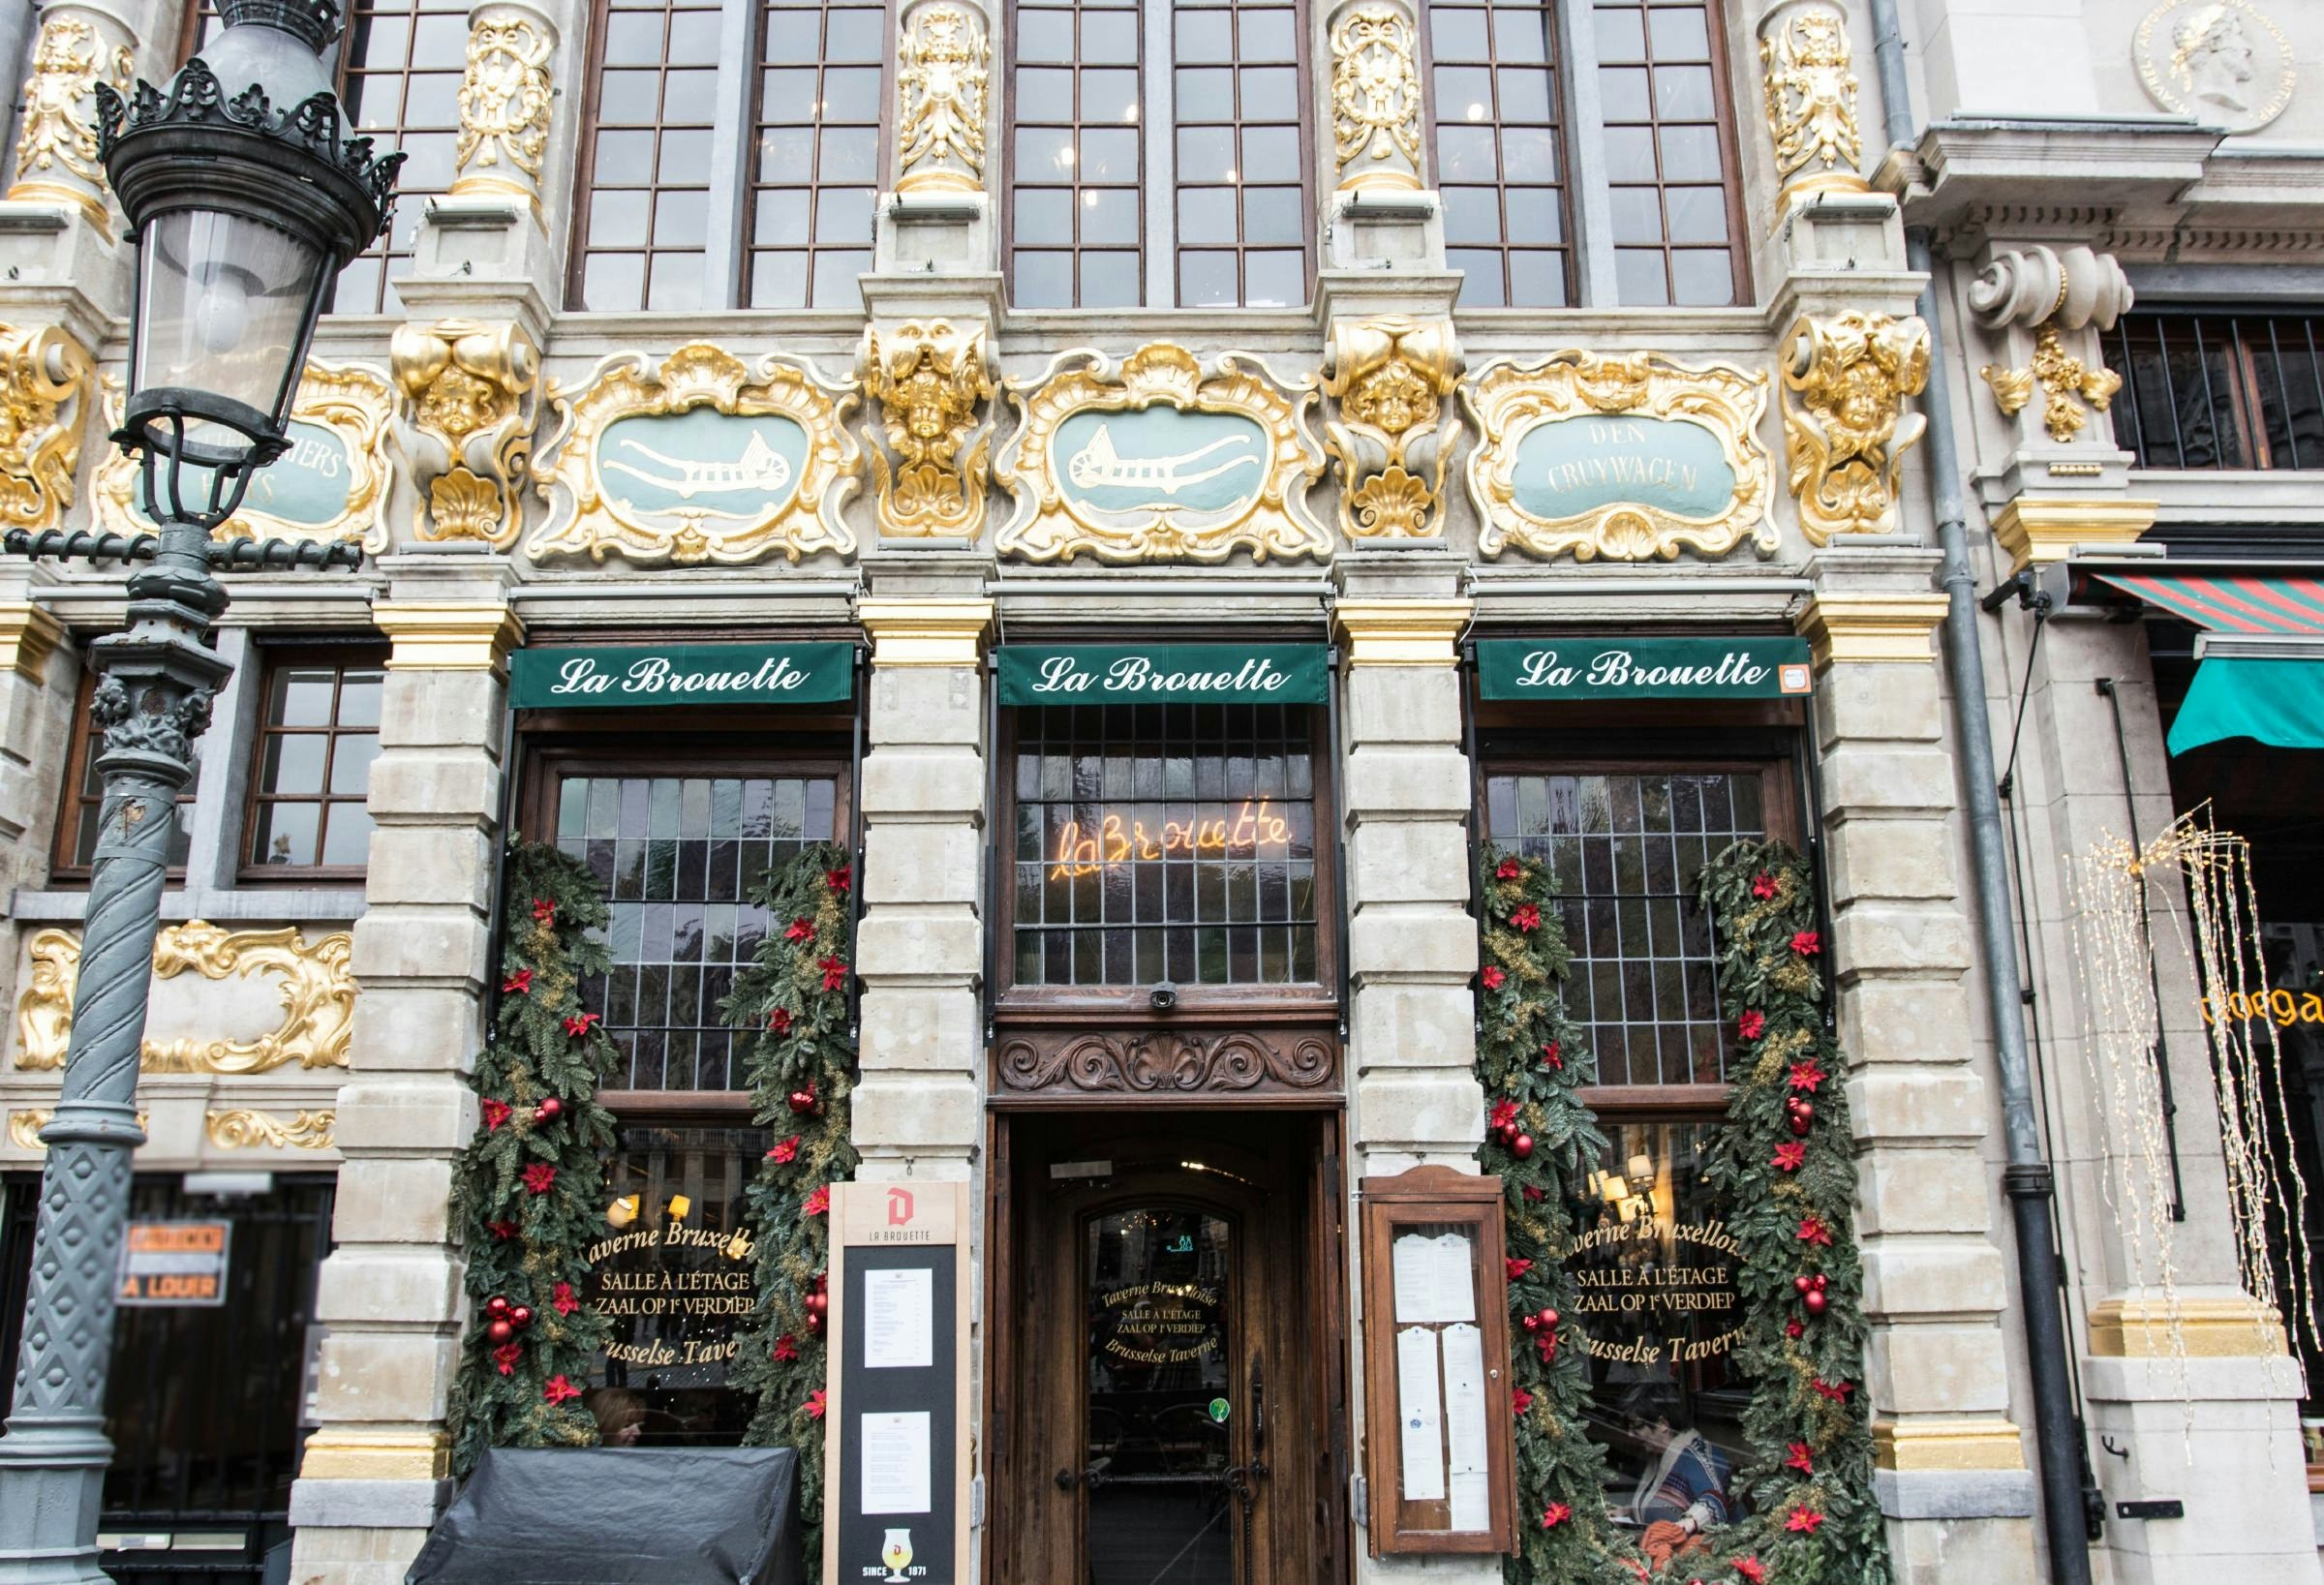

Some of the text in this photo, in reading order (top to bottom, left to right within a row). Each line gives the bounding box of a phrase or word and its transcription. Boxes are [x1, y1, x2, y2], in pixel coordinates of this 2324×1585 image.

[1589, 422, 1646, 444] DEN
[551, 656, 810, 693] La Brouette
[1032, 656, 1292, 692] La Brouette
[1515, 650, 1771, 686] La Brouette
[2200, 988, 2324, 1026] oega
[576, 1222, 755, 1264] averne Bruxello
[869, 1231, 931, 1241] LA BROUETTE
[1568, 1215, 1749, 1263] verne Bruxelloi
[601, 1269, 749, 1291] SALLE À L'ÉTAGE
[1576, 1265, 1729, 1287] SALLE À L'ÉTAGE
[596, 1297, 640, 1315] ZAAL
[642, 1297, 666, 1315] OP
[683, 1296, 755, 1315] VERDIEP
[1101, 1283, 1149, 1308] Taverne
[1573, 1294, 1619, 1311] ZAAL
[1620, 1293, 1645, 1311] OP
[1662, 1292, 1736, 1310] VERDIEP
[1121, 1308, 1202, 1320] SALLE À L'ÉTAGE
[1116, 1324, 1142, 1333] ZAAL
[1143, 1324, 1157, 1333] OP
[1166, 1324, 1207, 1333] VERDIEP
[602, 1337, 737, 1365] usselse Tave
[1105, 1336, 1218, 1363] Brusselse Taverne
[1667, 1326, 1747, 1362] Tavern
[862, 1566, 927, 1576] SINCE 1871
